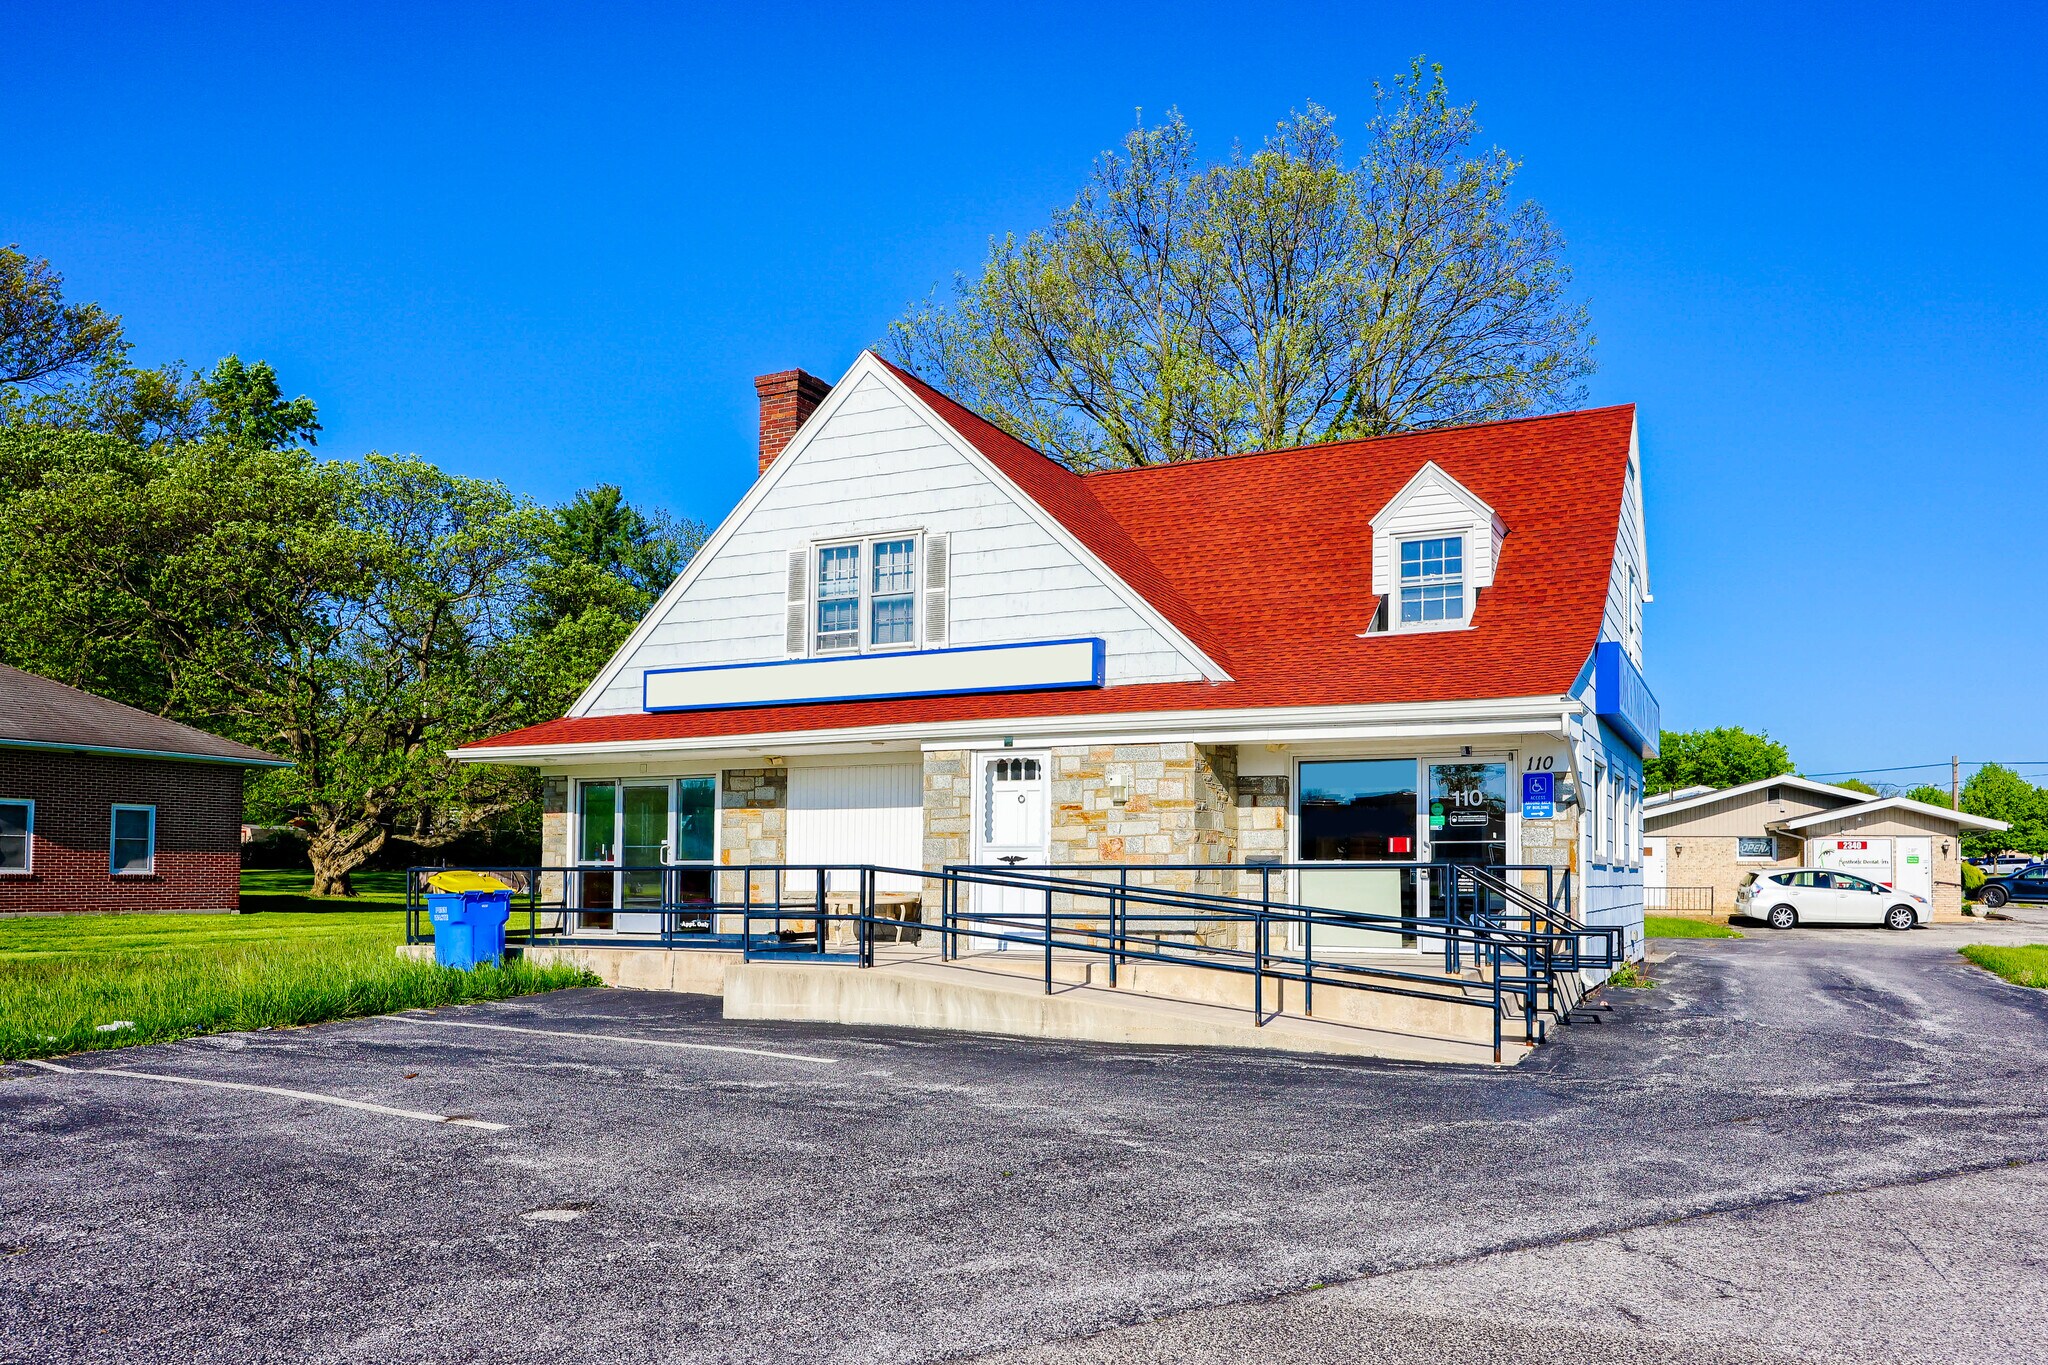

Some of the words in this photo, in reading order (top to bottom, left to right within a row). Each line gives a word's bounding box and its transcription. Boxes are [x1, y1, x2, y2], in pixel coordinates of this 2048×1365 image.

[1527, 755, 1554, 771] 110
[1452, 790, 1483, 807] 110
[1741, 843, 1768, 853] OPEN
[1842, 841, 1862, 850] 2340
[697, 921, 709, 929] Only
